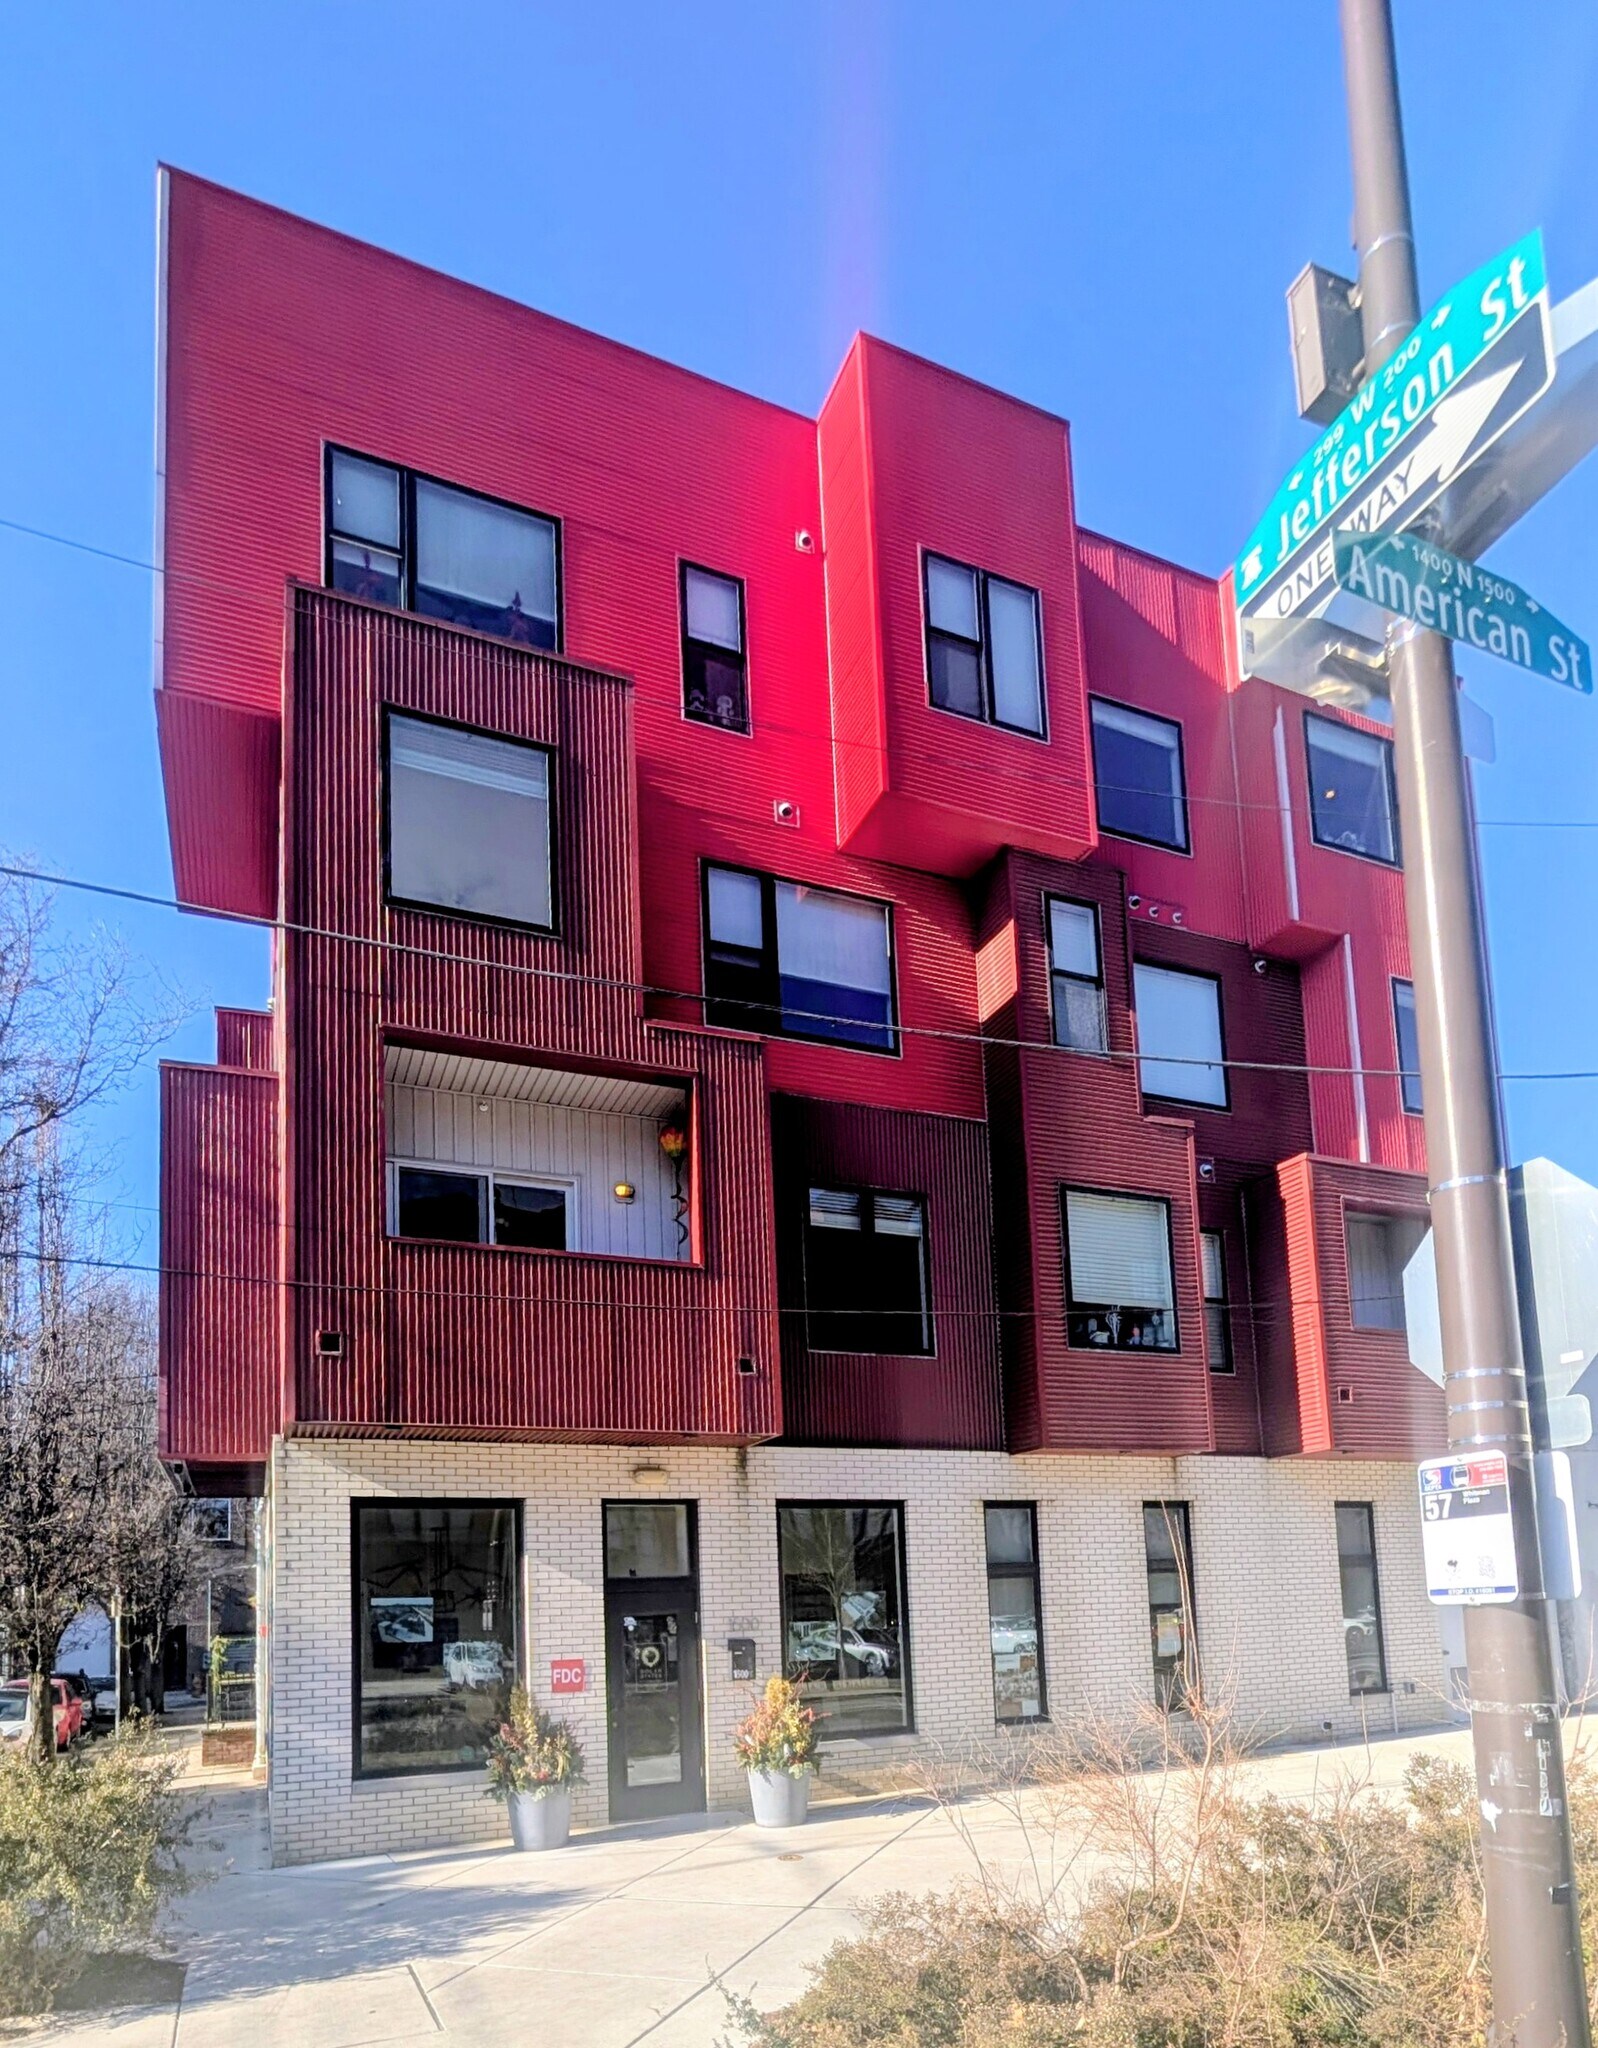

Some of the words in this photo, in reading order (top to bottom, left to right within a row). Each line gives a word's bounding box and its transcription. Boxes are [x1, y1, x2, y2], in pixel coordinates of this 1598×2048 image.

[1277, 341, 1454, 562] Jefferson
[1479, 253, 1529, 340] St
[1313, 423, 1344, 468] 299
[1350, 380, 1376, 424] W
[1383, 336, 1422, 389] 200
[1278, 541, 1333, 617] ONE
[1349, 454, 1416, 532] WAY
[1411, 545, 1452, 576] 1400
[1457, 562, 1473, 589] N
[1477, 575, 1515, 605] 1500
[1349, 544, 1532, 667] American
[1548, 635, 1584, 690] St
[1425, 1493, 1452, 1520] 57
[553, 1668, 581, 1684] FDC
